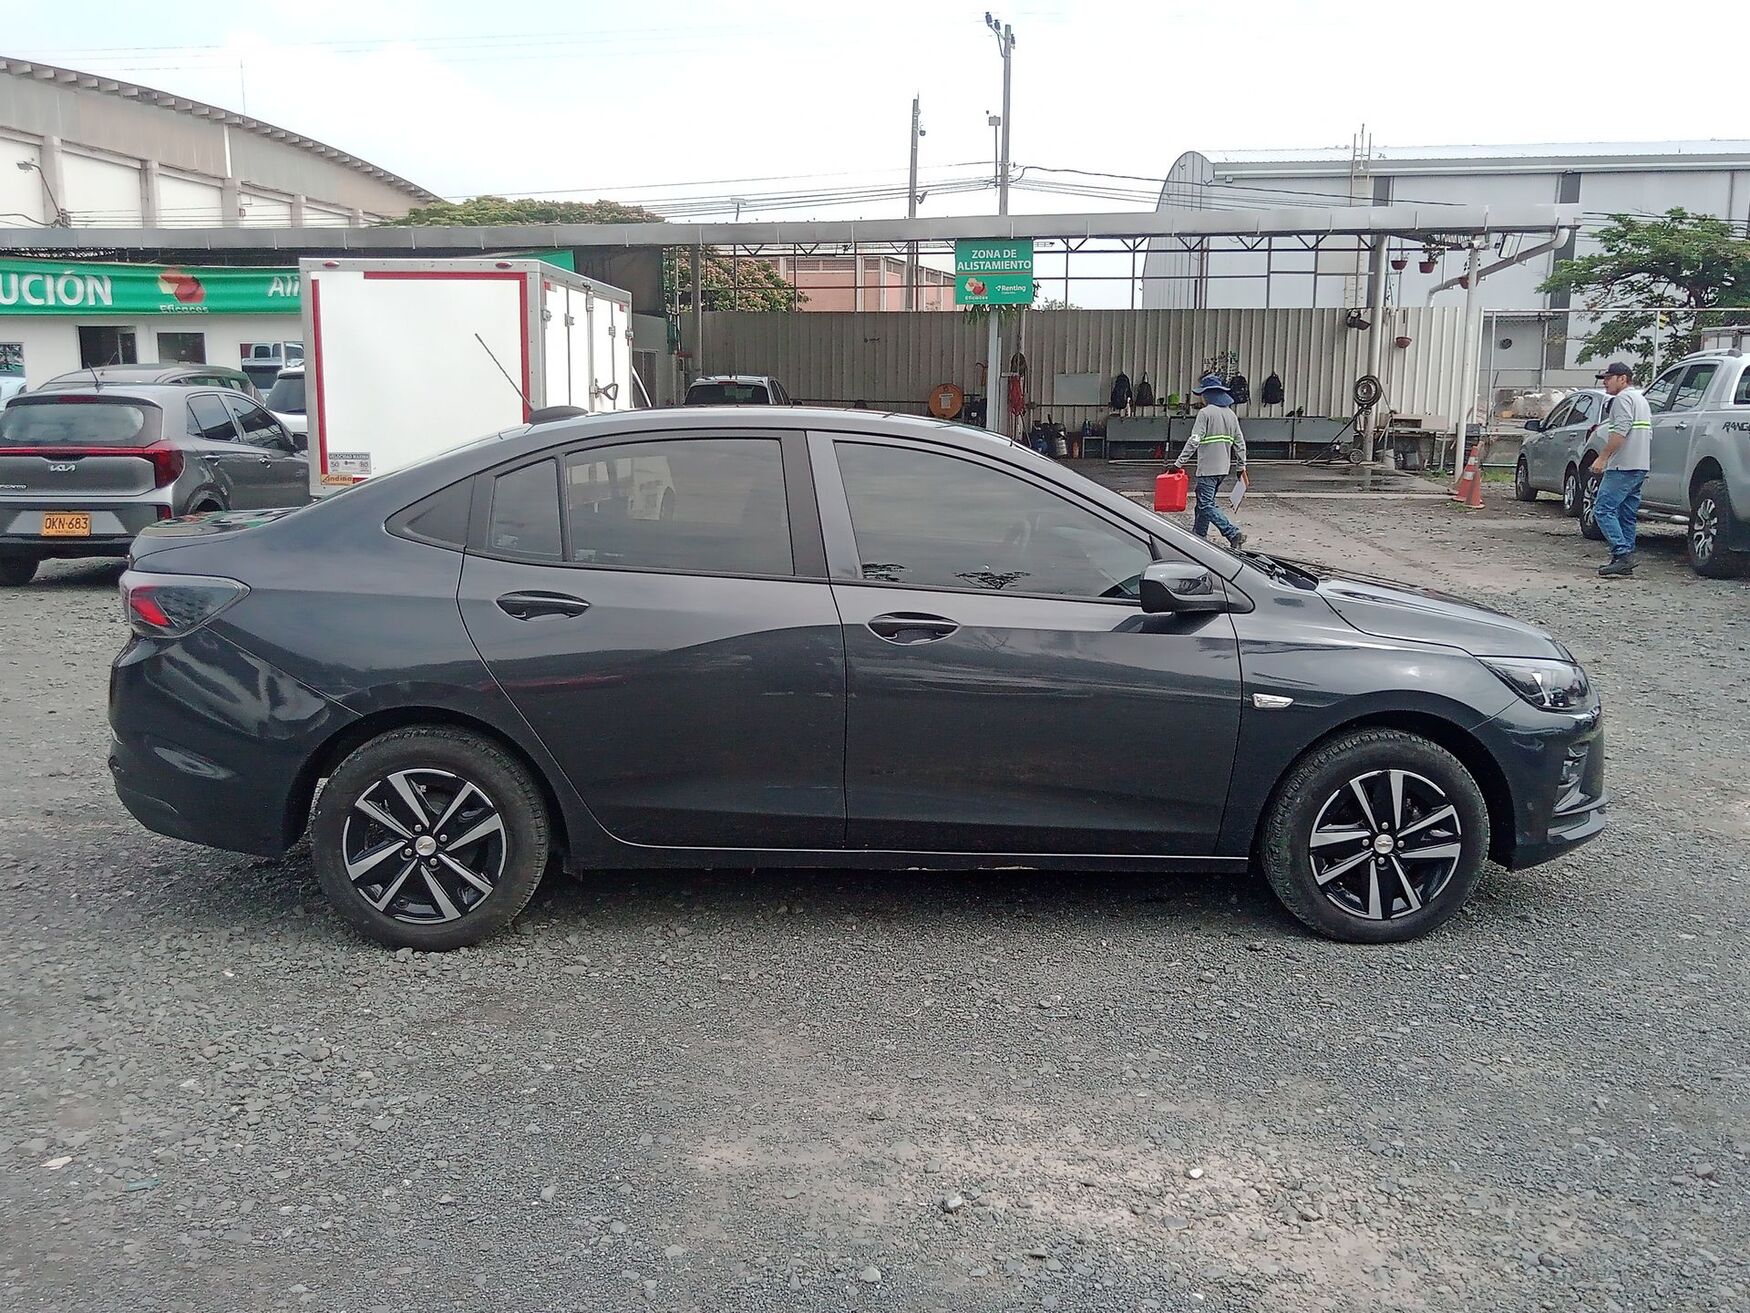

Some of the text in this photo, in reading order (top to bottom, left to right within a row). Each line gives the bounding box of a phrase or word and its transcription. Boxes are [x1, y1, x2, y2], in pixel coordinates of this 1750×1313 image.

[971, 249, 1017, 259] ZONA DE
[957, 260, 1032, 271] ALISTAMIENTO
[1001, 284, 1026, 292] Renting
[50, 464, 76, 472] KIA
